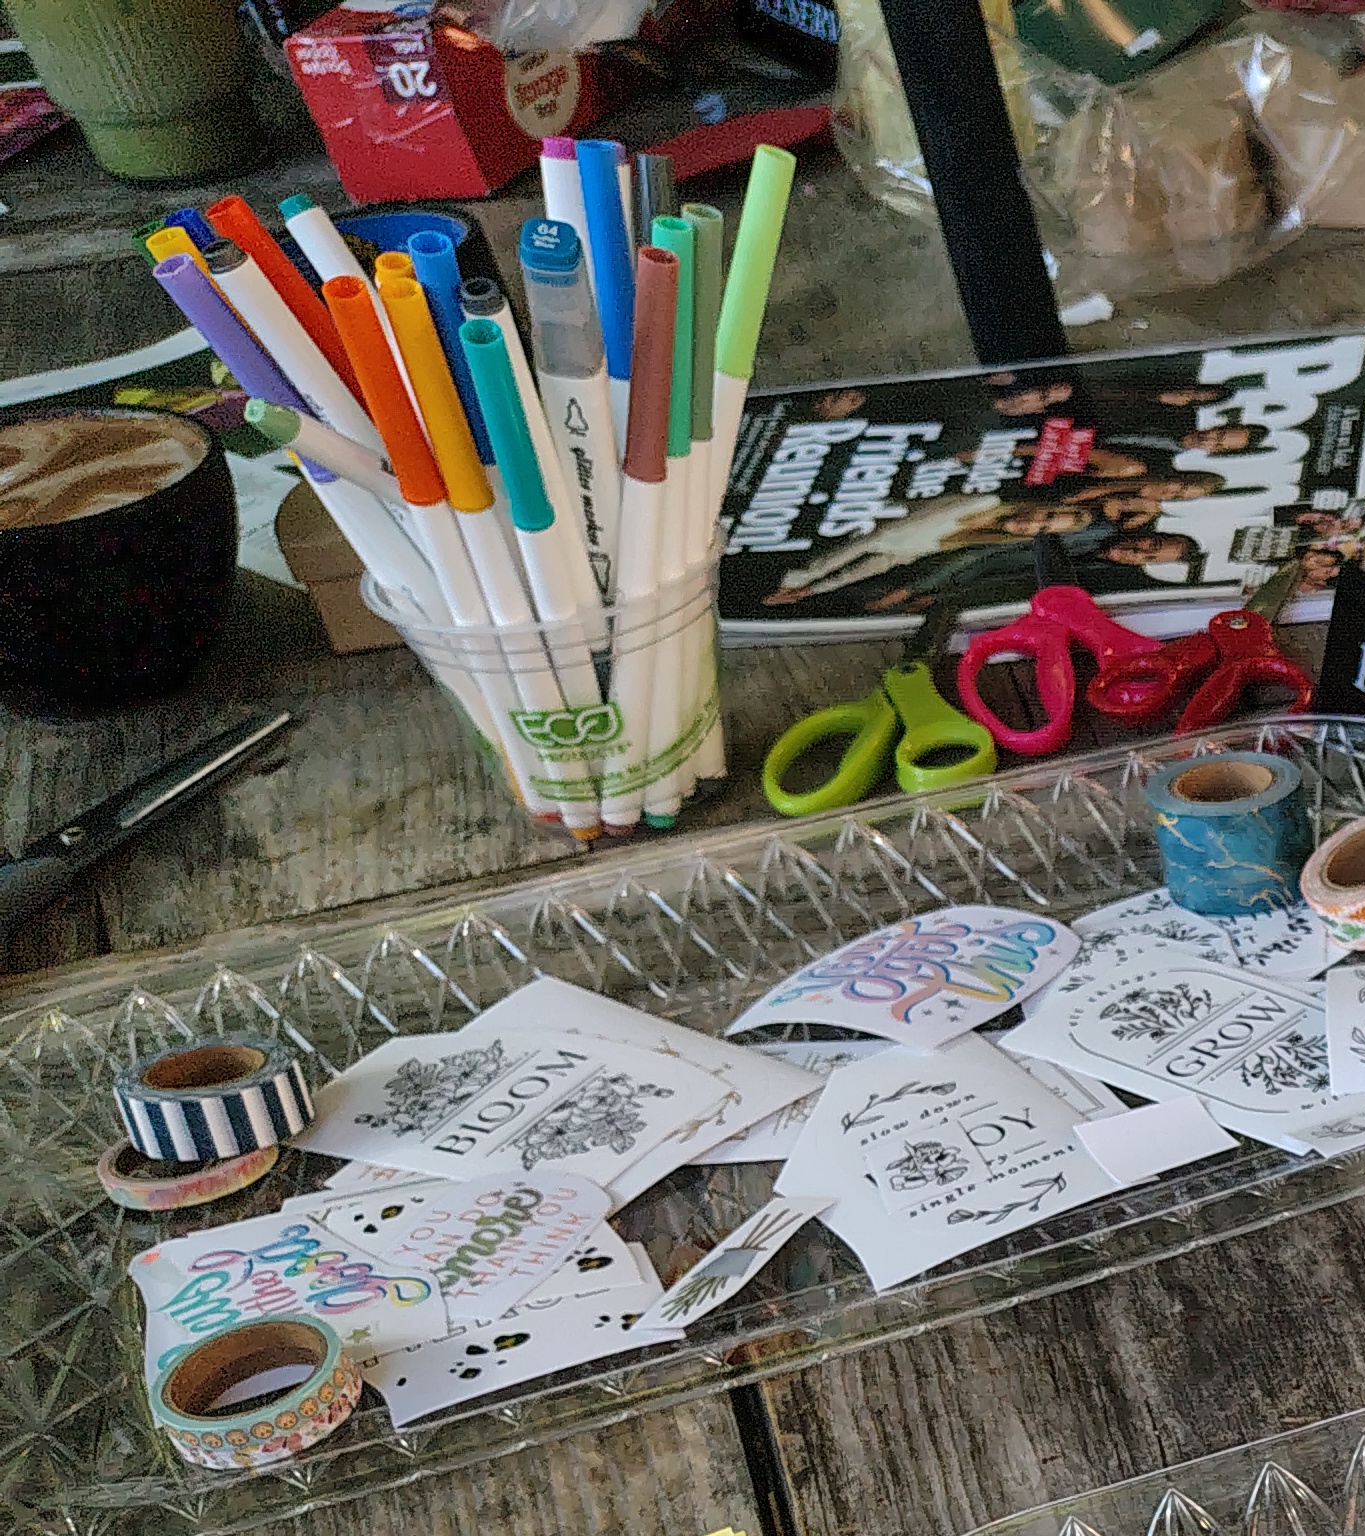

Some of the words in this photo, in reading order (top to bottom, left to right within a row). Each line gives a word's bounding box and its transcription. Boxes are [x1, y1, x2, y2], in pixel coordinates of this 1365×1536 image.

[387, 60, 438, 98] 20
[822, 418, 942, 538] Friends
[910, 449, 964, 499] the
[962, 428, 1036, 497] Inside
[1165, 995, 1287, 1079] GROW
[432, 1048, 589, 1157] BLOOM
[859, 1119, 910, 1147] slow
[919, 1092, 977, 1120] down
[985, 1143, 1076, 1184] moment
[395, 1207, 452, 1255] YOU
[508, 1212, 591, 1278] THINK
